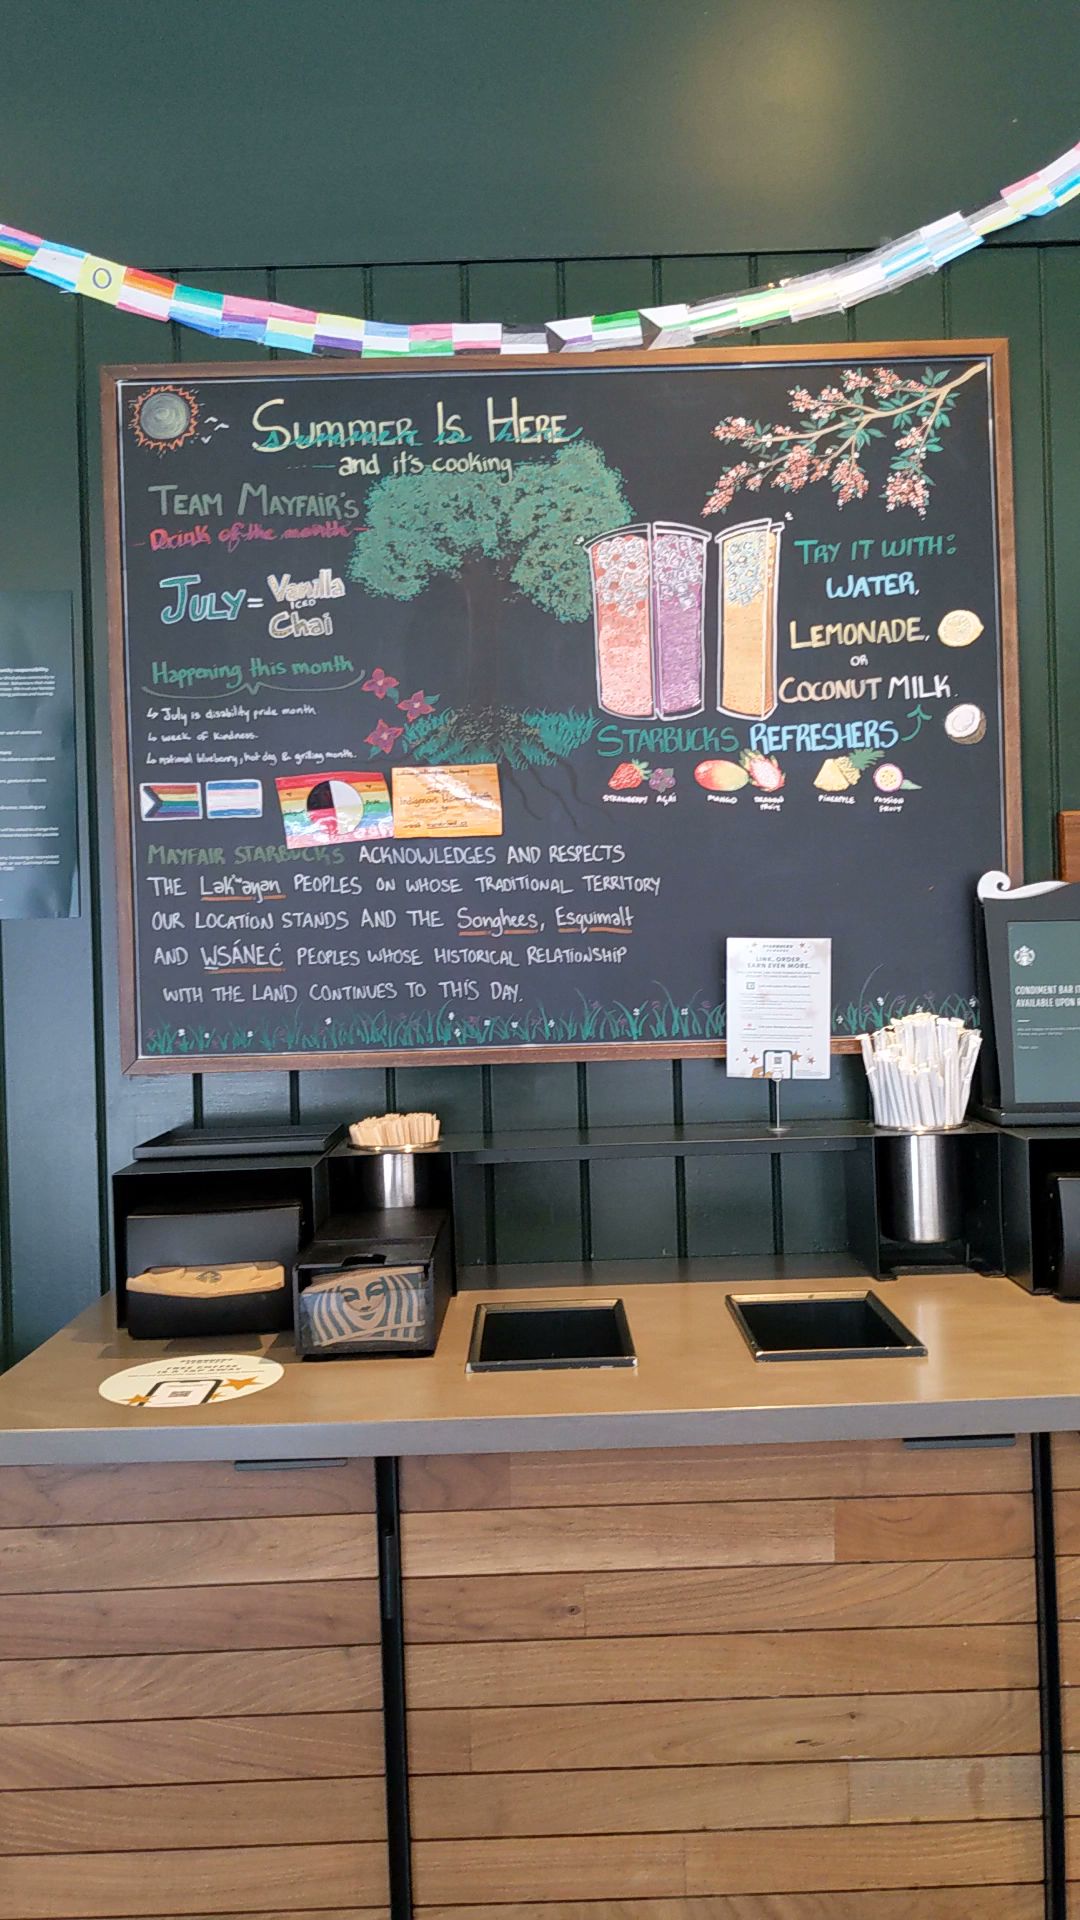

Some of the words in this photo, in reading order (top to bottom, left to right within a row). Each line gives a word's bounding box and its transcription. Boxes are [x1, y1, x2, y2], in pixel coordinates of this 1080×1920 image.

[487, 396, 569, 444] HERE
[338, 453, 380, 476] and
[393, 451, 423, 474] it's
[432, 452, 513, 484] cooking
[148, 484, 223, 516] TEAM
[149, 525, 212, 551] Drink
[218, 522, 245, 552] of
[246, 523, 277, 540] the
[281, 520, 351, 539] month
[794, 538, 840, 565] TRY
[852, 536, 873, 560] IT
[881, 532, 957, 557] WITH:
[267, 568, 345, 602] Vanilla
[826, 572, 920, 598] WATER,
[268, 611, 333, 639] Chai
[789, 616, 931, 649] LEMONADE,
[151, 661, 242, 688] Happening
[249, 657, 287, 677] this
[292, 655, 354, 674] month
[850, 655, 868, 667] OR
[778, 676, 883, 703] COCONUT
[161, 706, 188, 727] July
[191, 711, 201, 720] is
[205, 705, 250, 723] disability
[253, 706, 279, 720] pride
[281, 704, 317, 715] month
[161, 732, 192, 742] week
[196, 730, 209, 741] of
[597, 724, 739, 756] STARBUCKS
[749, 719, 899, 754] REFRESHERS
[159, 752, 193, 765] national
[244, 752, 261, 761] hot
[262, 751, 278, 766] dog
[707, 794, 738, 805] MANGO
[147, 844, 225, 865] MAYFAIR
[358, 846, 496, 865] ACKNOWLEDGES
[507, 845, 540, 865] AND
[549, 844, 626, 864] RESPECTS
[147, 876, 187, 896] THE
[293, 874, 363, 895] PEOPLES
[376, 877, 396, 891] ON
[406, 877, 463, 893] WHOSE
[475, 875, 574, 894] TRADITIONAL
[582, 875, 661, 896] TERRITORY
[151, 911, 185, 930] OUR
[195, 911, 274, 930] LOCATION
[281, 911, 349, 930] STANDS
[361, 908, 396, 928] AND
[406, 910, 444, 928] THE
[457, 906, 545, 937] Songhees,
[556, 906, 634, 934] Esquimalt
[154, 946, 188, 965] AND
[297, 947, 360, 965] PEOPLES
[367, 948, 423, 966] WHOSE
[434, 948, 520, 967] HISTORICAL
[527, 946, 627, 964] RELATIONSHIP
[163, 986, 203, 1002] WITH
[212, 985, 245, 1002] THE
[252, 983, 297, 1002] LAND
[309, 982, 397, 1001] CONTINUES
[405, 982, 426, 998] TO
[438, 979, 480, 999] THIS
[490, 981, 523, 1002] DAY.
[1015, 985, 1057, 995] CONDIMENT
[1058, 984, 1073, 994] BAR
[1016, 998, 1055, 1007] AVAILABLE
[1055, 997, 1076, 1007] UPON
